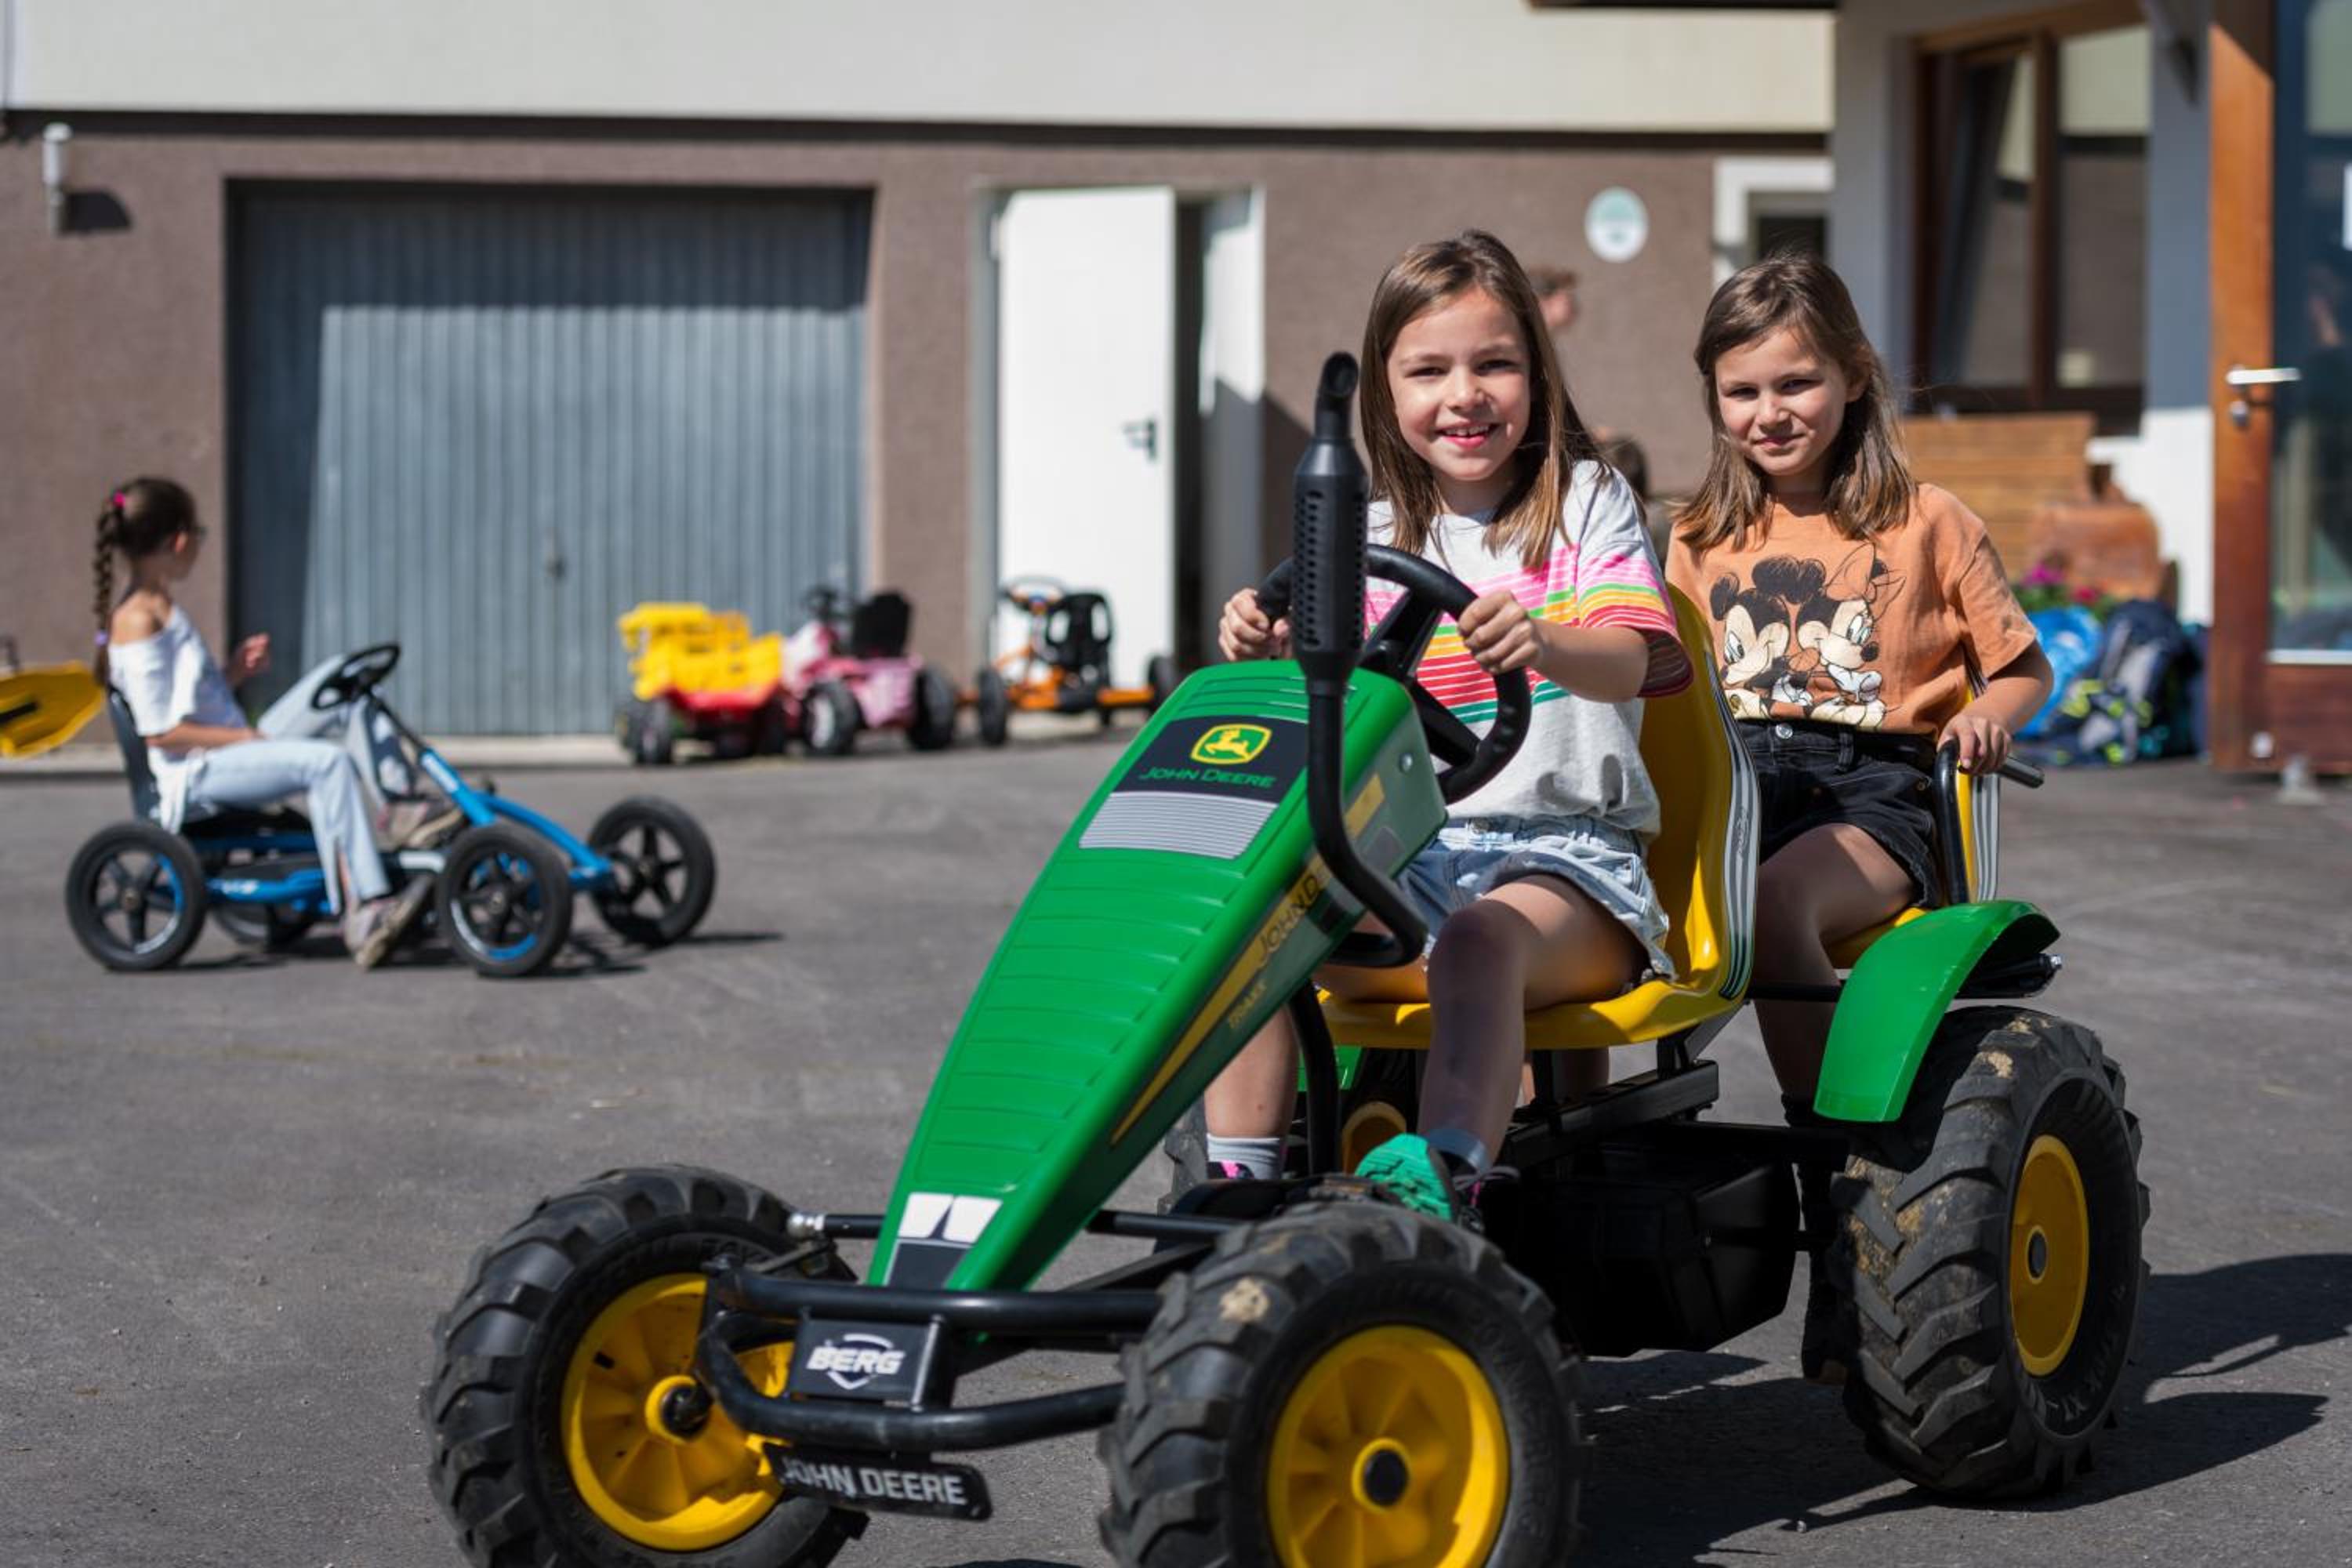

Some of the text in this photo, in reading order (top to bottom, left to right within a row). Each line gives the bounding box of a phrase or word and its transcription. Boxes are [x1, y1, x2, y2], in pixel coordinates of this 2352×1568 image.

[1138, 767, 1276, 788] JOHN DEERE
[806, 1345, 905, 1374] BERG
[779, 1456, 967, 1504] JOHN DEERE
